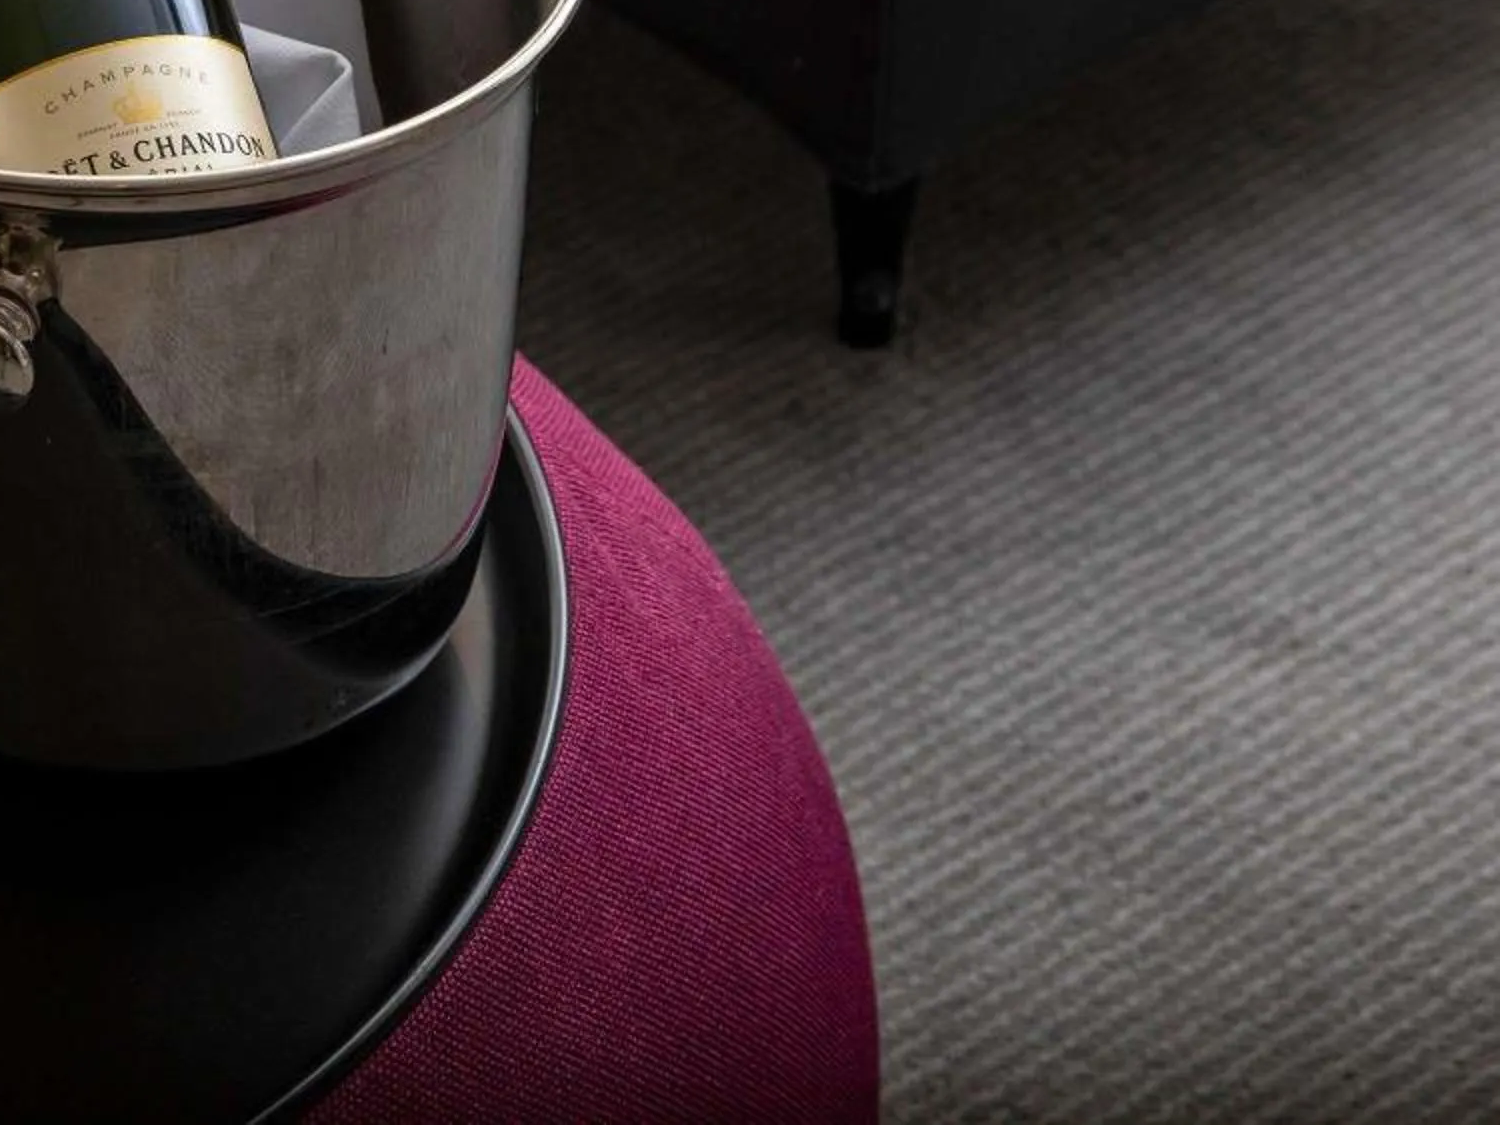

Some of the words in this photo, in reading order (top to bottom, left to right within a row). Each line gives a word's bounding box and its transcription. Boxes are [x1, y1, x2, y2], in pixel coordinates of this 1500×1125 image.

[44, 64, 209, 114] CHAMPAGNE
[109, 150, 130, 171] &
[133, 131, 266, 162] CHANDON
